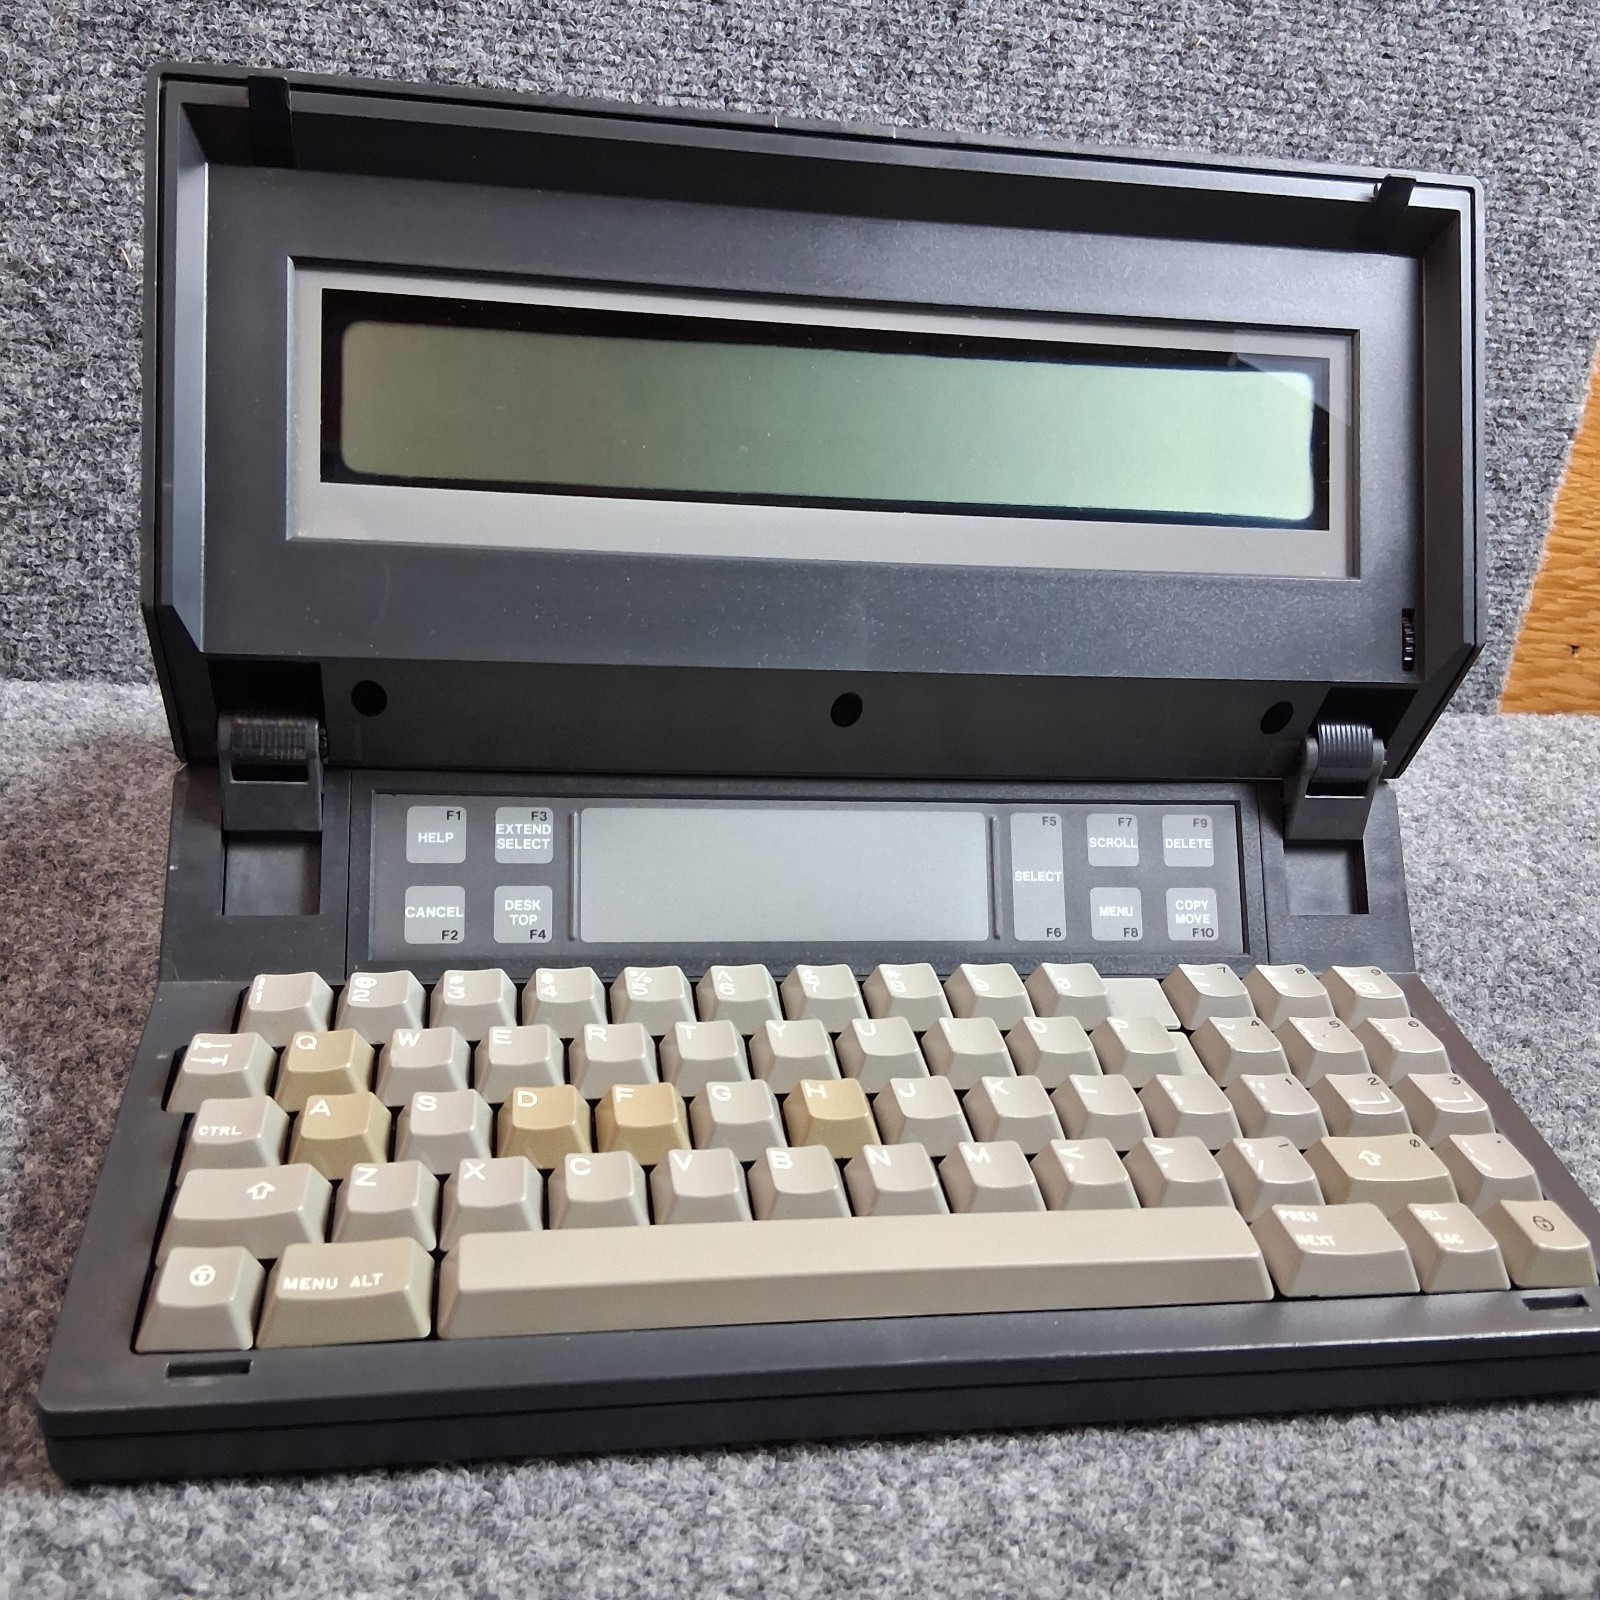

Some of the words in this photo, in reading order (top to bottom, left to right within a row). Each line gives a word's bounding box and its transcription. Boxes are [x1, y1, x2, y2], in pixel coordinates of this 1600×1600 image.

[446, 810, 461, 821] F1
[531, 811, 547, 821] F3
[1042, 816, 1057, 826] F5
[1118, 817, 1133, 827] F7
[495, 823, 552, 835] EXTEND
[1193, 818, 1208, 828] F9
[418, 832, 454, 843] HELP
[496, 838, 551, 849] SELECT
[1089, 837, 1138, 848] SCROLL
[1165, 838, 1212, 849] DELETE
[1014, 871, 1063, 882] SELECT
[404, 906, 464, 918] CANCEL
[504, 899, 542, 911] DESK
[1099, 906, 1134, 917] MENU
[1175, 899, 1209, 911] COPY
[509, 914, 538, 926] TOP
[1175, 914, 1210, 925] MOVE
[441, 929, 459, 941] F2
[529, 929, 547, 940] F4
[1046, 927, 1062, 938] F6
[1123, 927, 1139, 938] F8
[1192, 927, 1215, 938] F10
[1216, 966, 1227, 974] 7
[1294, 967, 1306, 976] 8
[1369, 968, 1382, 977] 9
[351, 989, 371, 1003] 2
[447, 986, 466, 1000] 3
[540, 984, 558, 998] 4
[630, 982, 649, 996] 5
[718, 982, 736, 996] 6
[768, 1023, 787, 1038] Y
[855, 1021, 877, 1037] U
[1027, 1019, 1048, 1035] O
[1328, 1020, 1341, 1029] 5
[1407, 1020, 1420, 1029] 6
[491, 1028, 513, 1045] E
[586, 1026, 608, 1042] R
[678, 1024, 697, 1040] T
[295, 1034, 318, 1051] Q
[396, 1031, 421, 1048] W
[985, 1078, 1010, 1096] K
[1072, 1077, 1098, 1094] L
[1366, 1077, 1381, 1086] 2
[1448, 1076, 1462, 1086] 3
[614, 1086, 636, 1104] F
[710, 1084, 733, 1102] G
[803, 1082, 828, 1100] H
[897, 1082, 917, 1098] J
[415, 1095, 438, 1112] S
[516, 1090, 539, 1108] D
[309, 1099, 331, 1117] A
[198, 1125, 242, 1137] CTRL
[671, 1151, 694, 1172] V
[767, 1150, 794, 1170] B
[866, 1147, 892, 1167] N
[961, 1145, 992, 1164] M
[462, 1161, 487, 1181] X
[568, 1157, 593, 1176] C
[354, 1166, 378, 1187] Z
[1277, 1208, 1319, 1223] PREV
[1413, 1207, 1448, 1221] DEL
[1294, 1233, 1337, 1248] NEXT
[282, 1276, 340, 1291] MENU
[349, 1272, 384, 1288] ALT
